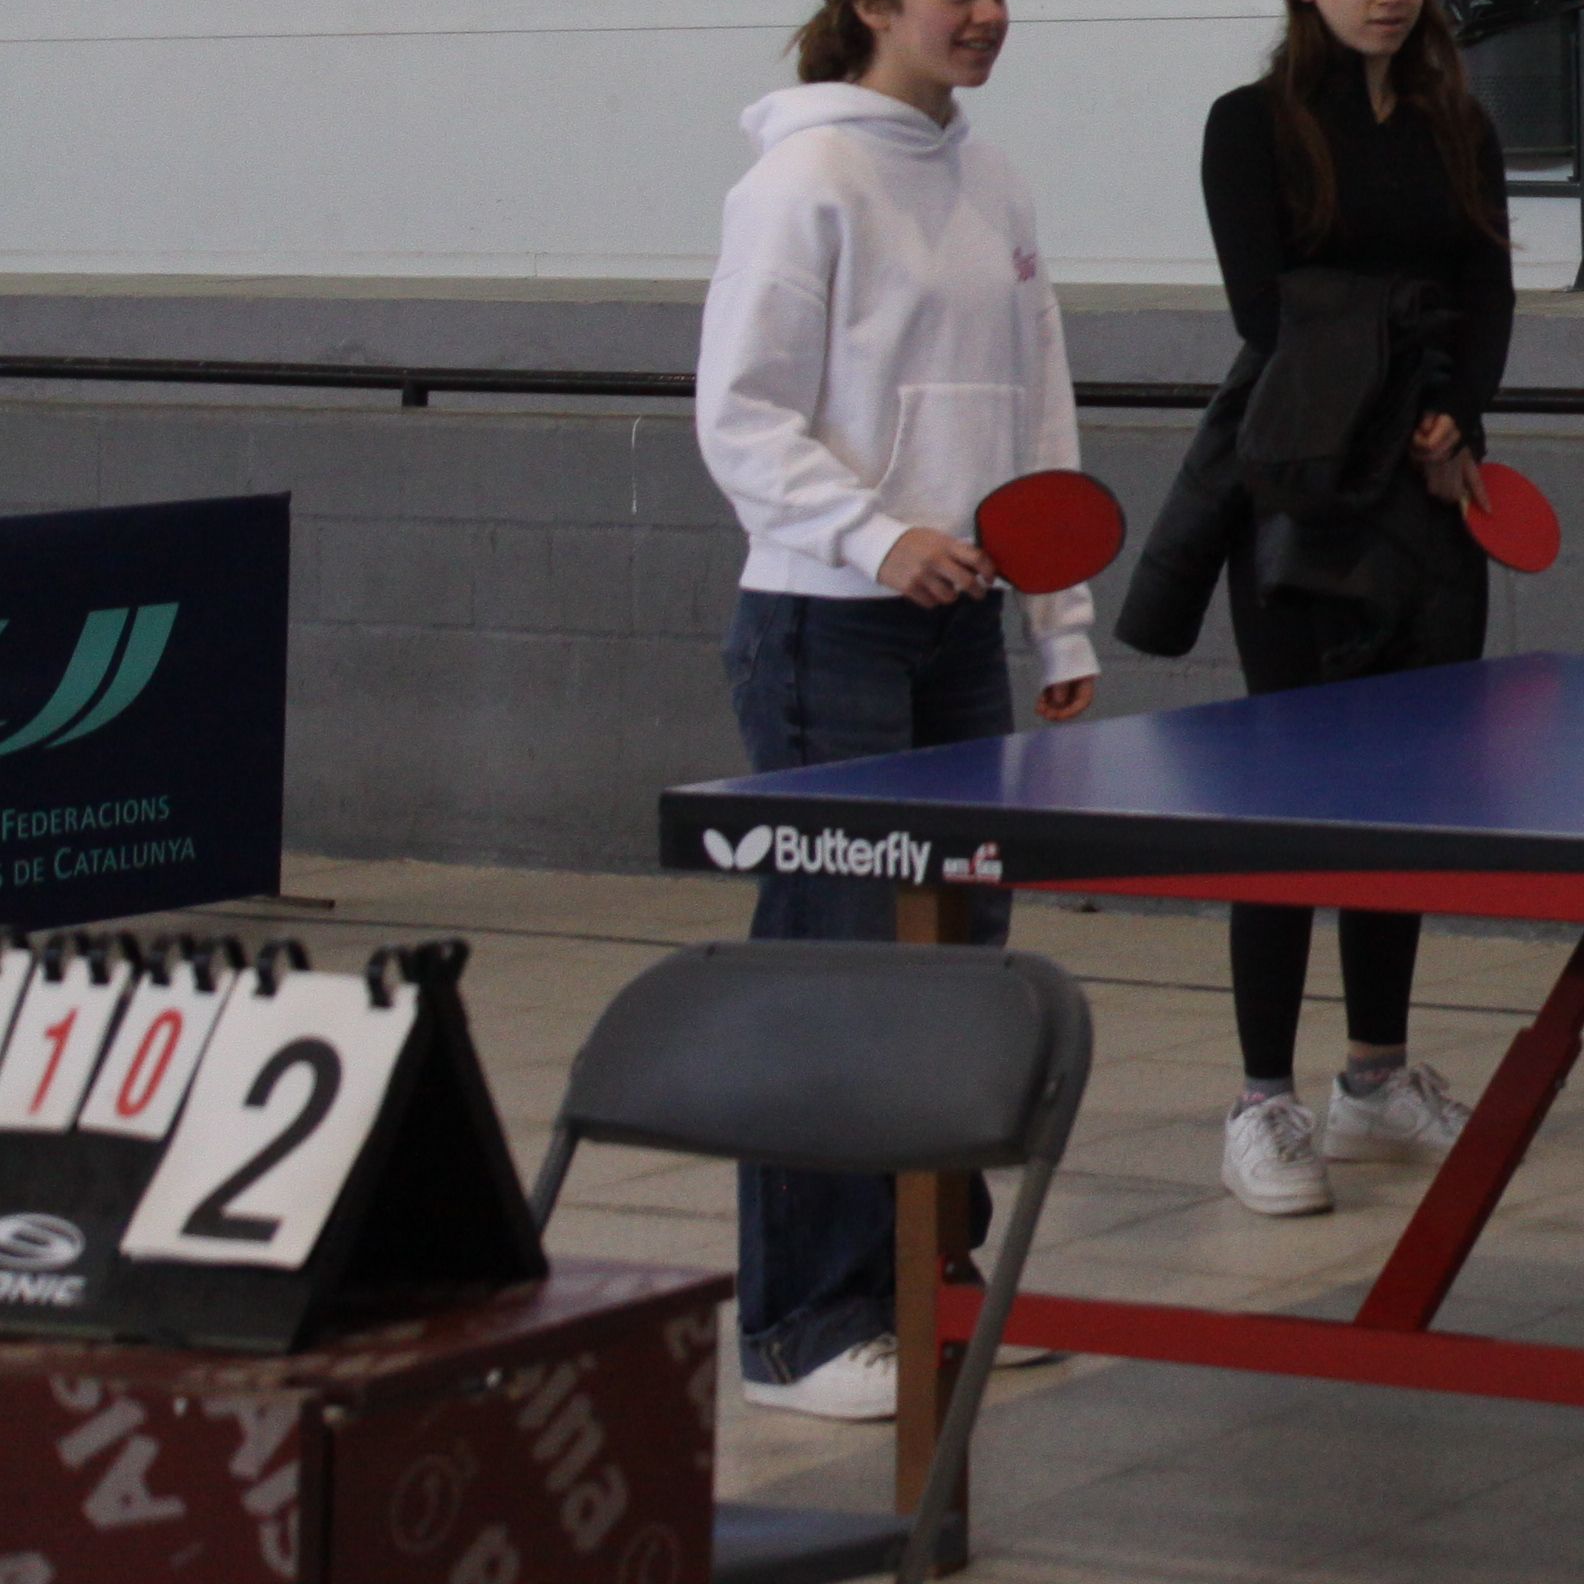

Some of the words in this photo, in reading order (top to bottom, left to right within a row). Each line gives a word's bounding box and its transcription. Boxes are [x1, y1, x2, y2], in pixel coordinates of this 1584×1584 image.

[13, 856, 45, 888] DE
[53, 835, 197, 881] CATALUNYA
[773, 824, 933, 886] Butterfly
[28, 1006, 79, 1116] 1
[116, 1007, 184, 1120] 0
[181, 1035, 344, 1245] 2
